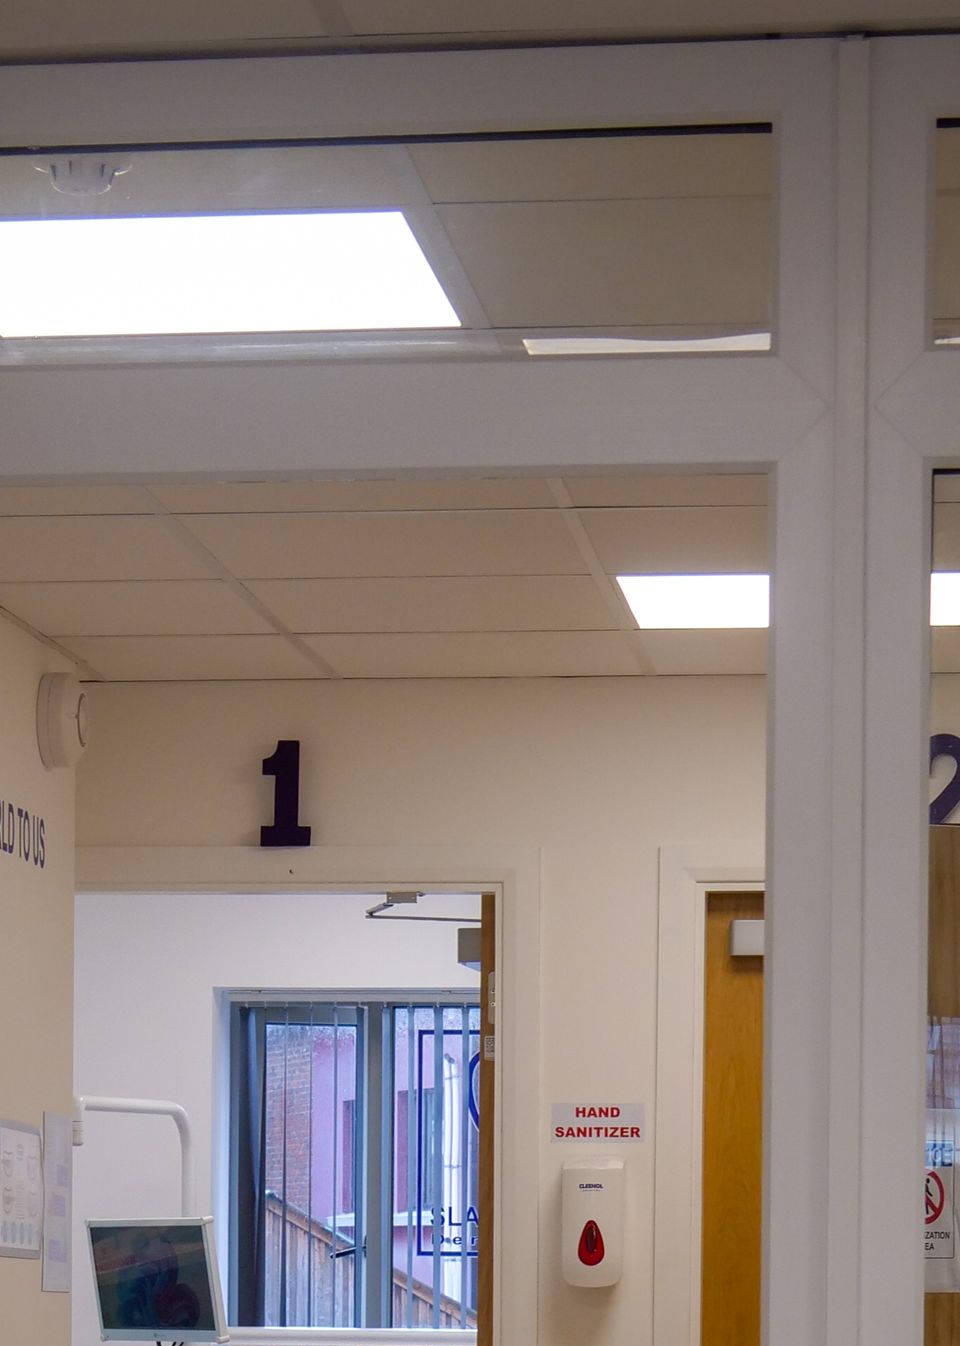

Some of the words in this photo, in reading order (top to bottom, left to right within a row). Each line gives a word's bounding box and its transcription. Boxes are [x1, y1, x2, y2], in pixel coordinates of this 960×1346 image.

[260, 740, 311, 847] 1
[928, 733, 960, 825] 2
[17, 808, 30, 861] TO
[32, 815, 45, 869] US
[555, 1127, 640, 1138] SANITIZER
[575, 1107, 620, 1118] HAND
